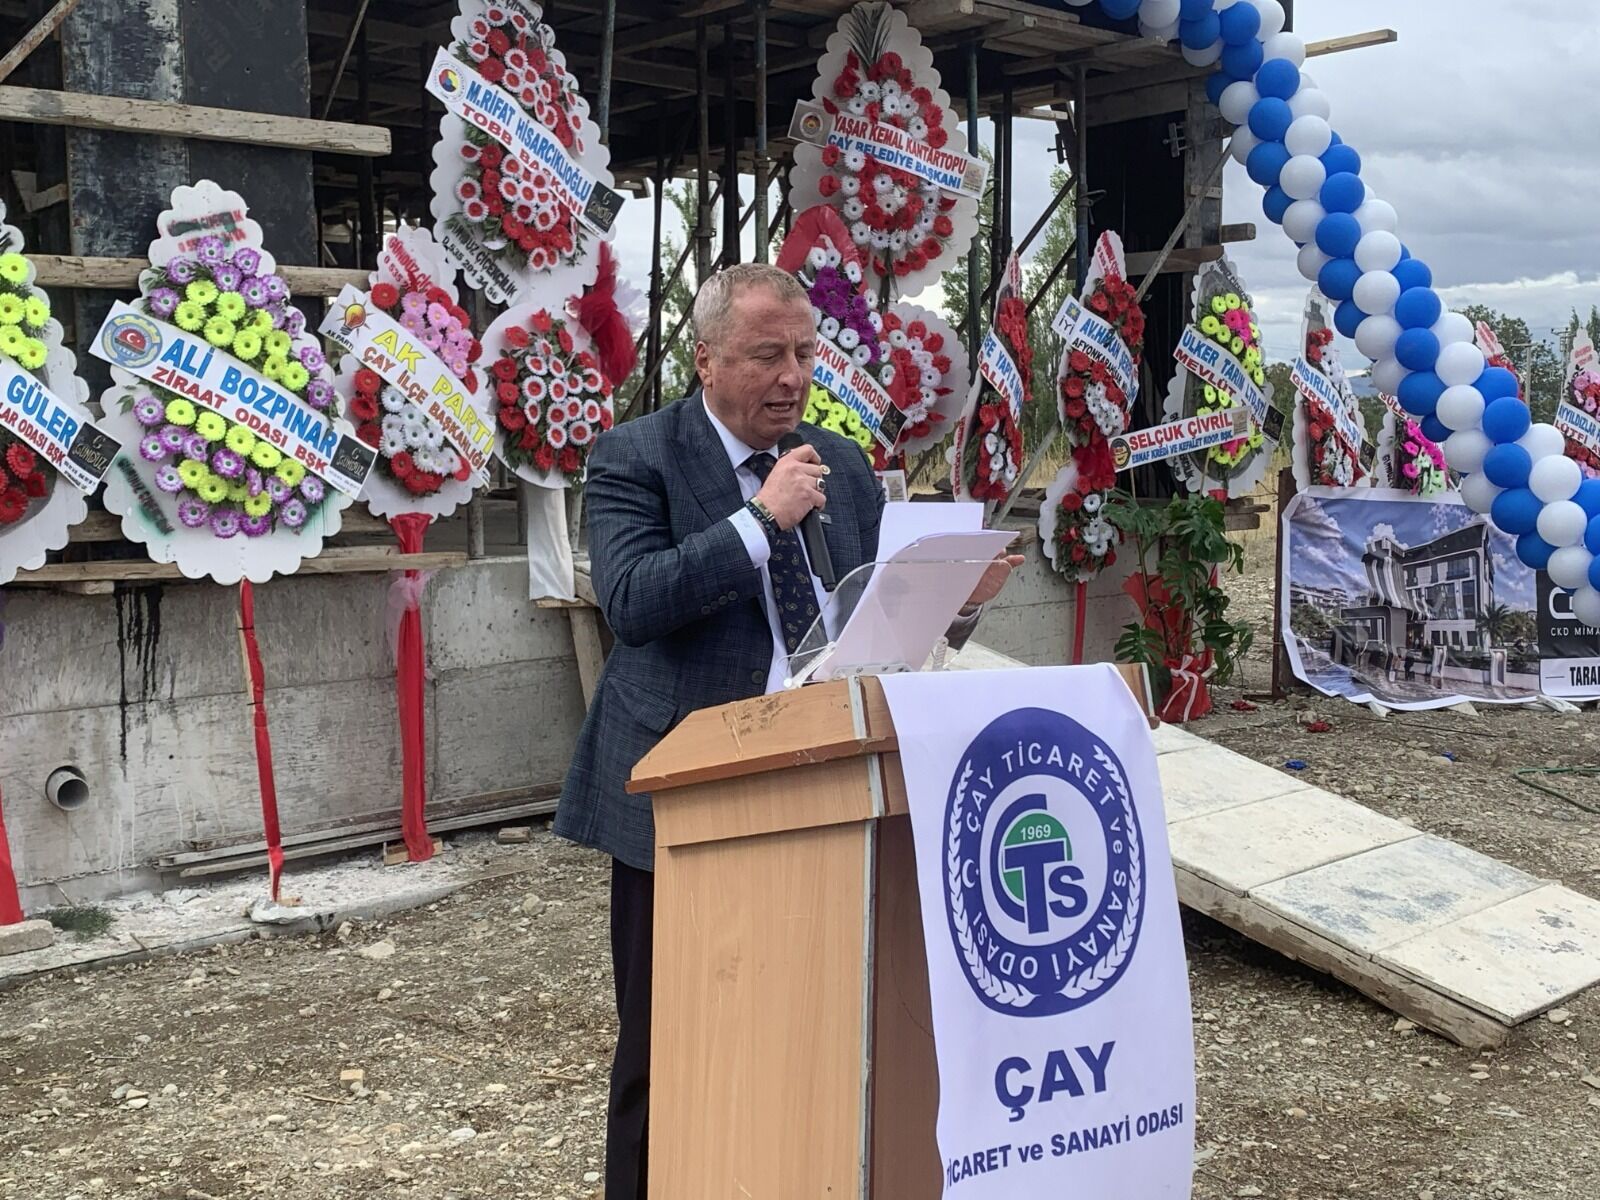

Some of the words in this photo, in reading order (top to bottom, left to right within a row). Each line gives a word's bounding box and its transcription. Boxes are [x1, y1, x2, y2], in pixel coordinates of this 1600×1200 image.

[462, 102, 513, 146] TOBB
[466, 80, 516, 127] M.RİFAT
[515, 117, 593, 202] HİSARCIKLIOĞLU
[833, 113, 868, 140] YAŞAR
[868, 122, 904, 149] KEMAL
[905, 137, 967, 175] KANTARTOPU
[914, 160, 962, 190] BAŞKANI
[447, 243, 465, 262] 535
[462, 259, 478, 277] 201
[371, 328, 427, 375] AK
[1058, 315, 1076, 336] İYİ
[814, 340, 850, 378] UKUK
[850, 369, 891, 417] BÜROSU
[1174, 348, 1237, 398] MEVLÜT
[1181, 328, 1220, 368] ÜLKER
[1220, 358, 1246, 392] TARIM
[6, 374, 79, 449] GÜLER
[151, 365, 228, 410] ZİRAAT
[234, 407, 289, 448] ODASI
[294, 443, 329, 476] BŞK
[160, 337, 216, 380] ALİ
[219, 365, 338, 459] BOZPINAR
[362, 346, 397, 373] ÇAY
[396, 369, 429, 405] İLÇE
[428, 401, 487, 470] BAŞKANLIĞI
[838, 383, 881, 435] DÜNDAR
[18, 418, 49, 450] ODASI
[45, 441, 67, 467] BŞK
[1129, 423, 1185, 452] SELÇUK
[1187, 411, 1233, 439] ÇİVRİL
[1551, 627, 1570, 637] CKD
[966, 766, 994, 833] ÇAY
[1001, 740, 1115, 807] TİCARET
[1020, 824, 1052, 841] 1969
[1110, 818, 1123, 855] ve
[972, 911, 1039, 980] ODASI
[1052, 869, 1127, 980] SANAYİ
[994, 1040, 1116, 1122] ÇAY
[1017, 1143, 1044, 1162] ve
[1051, 1114, 1131, 1157] SANAYİ
[1135, 1102, 1184, 1138] ODASI
